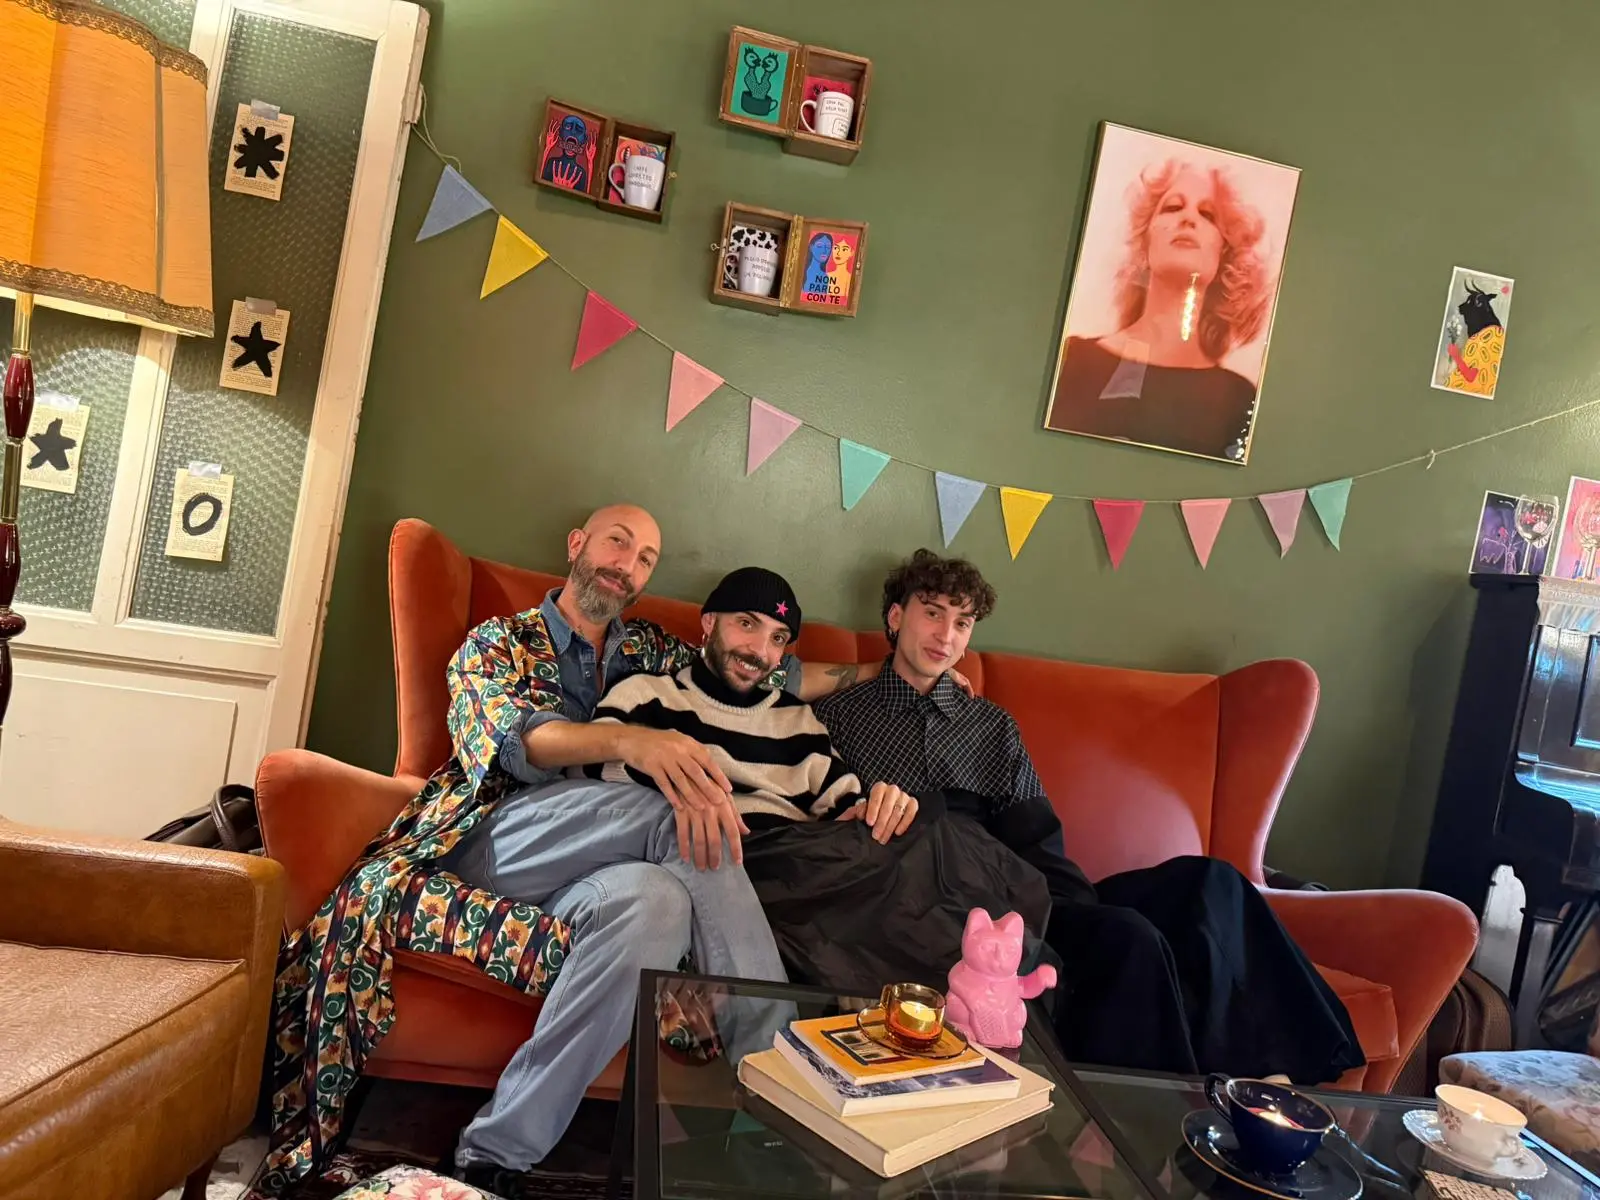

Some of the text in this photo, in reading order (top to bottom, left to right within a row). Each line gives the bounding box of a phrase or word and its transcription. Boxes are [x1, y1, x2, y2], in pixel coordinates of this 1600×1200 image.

[815, 275, 836, 285] NON
[809, 283, 840, 295] PARLO
[806, 293, 841, 305] CON TE
